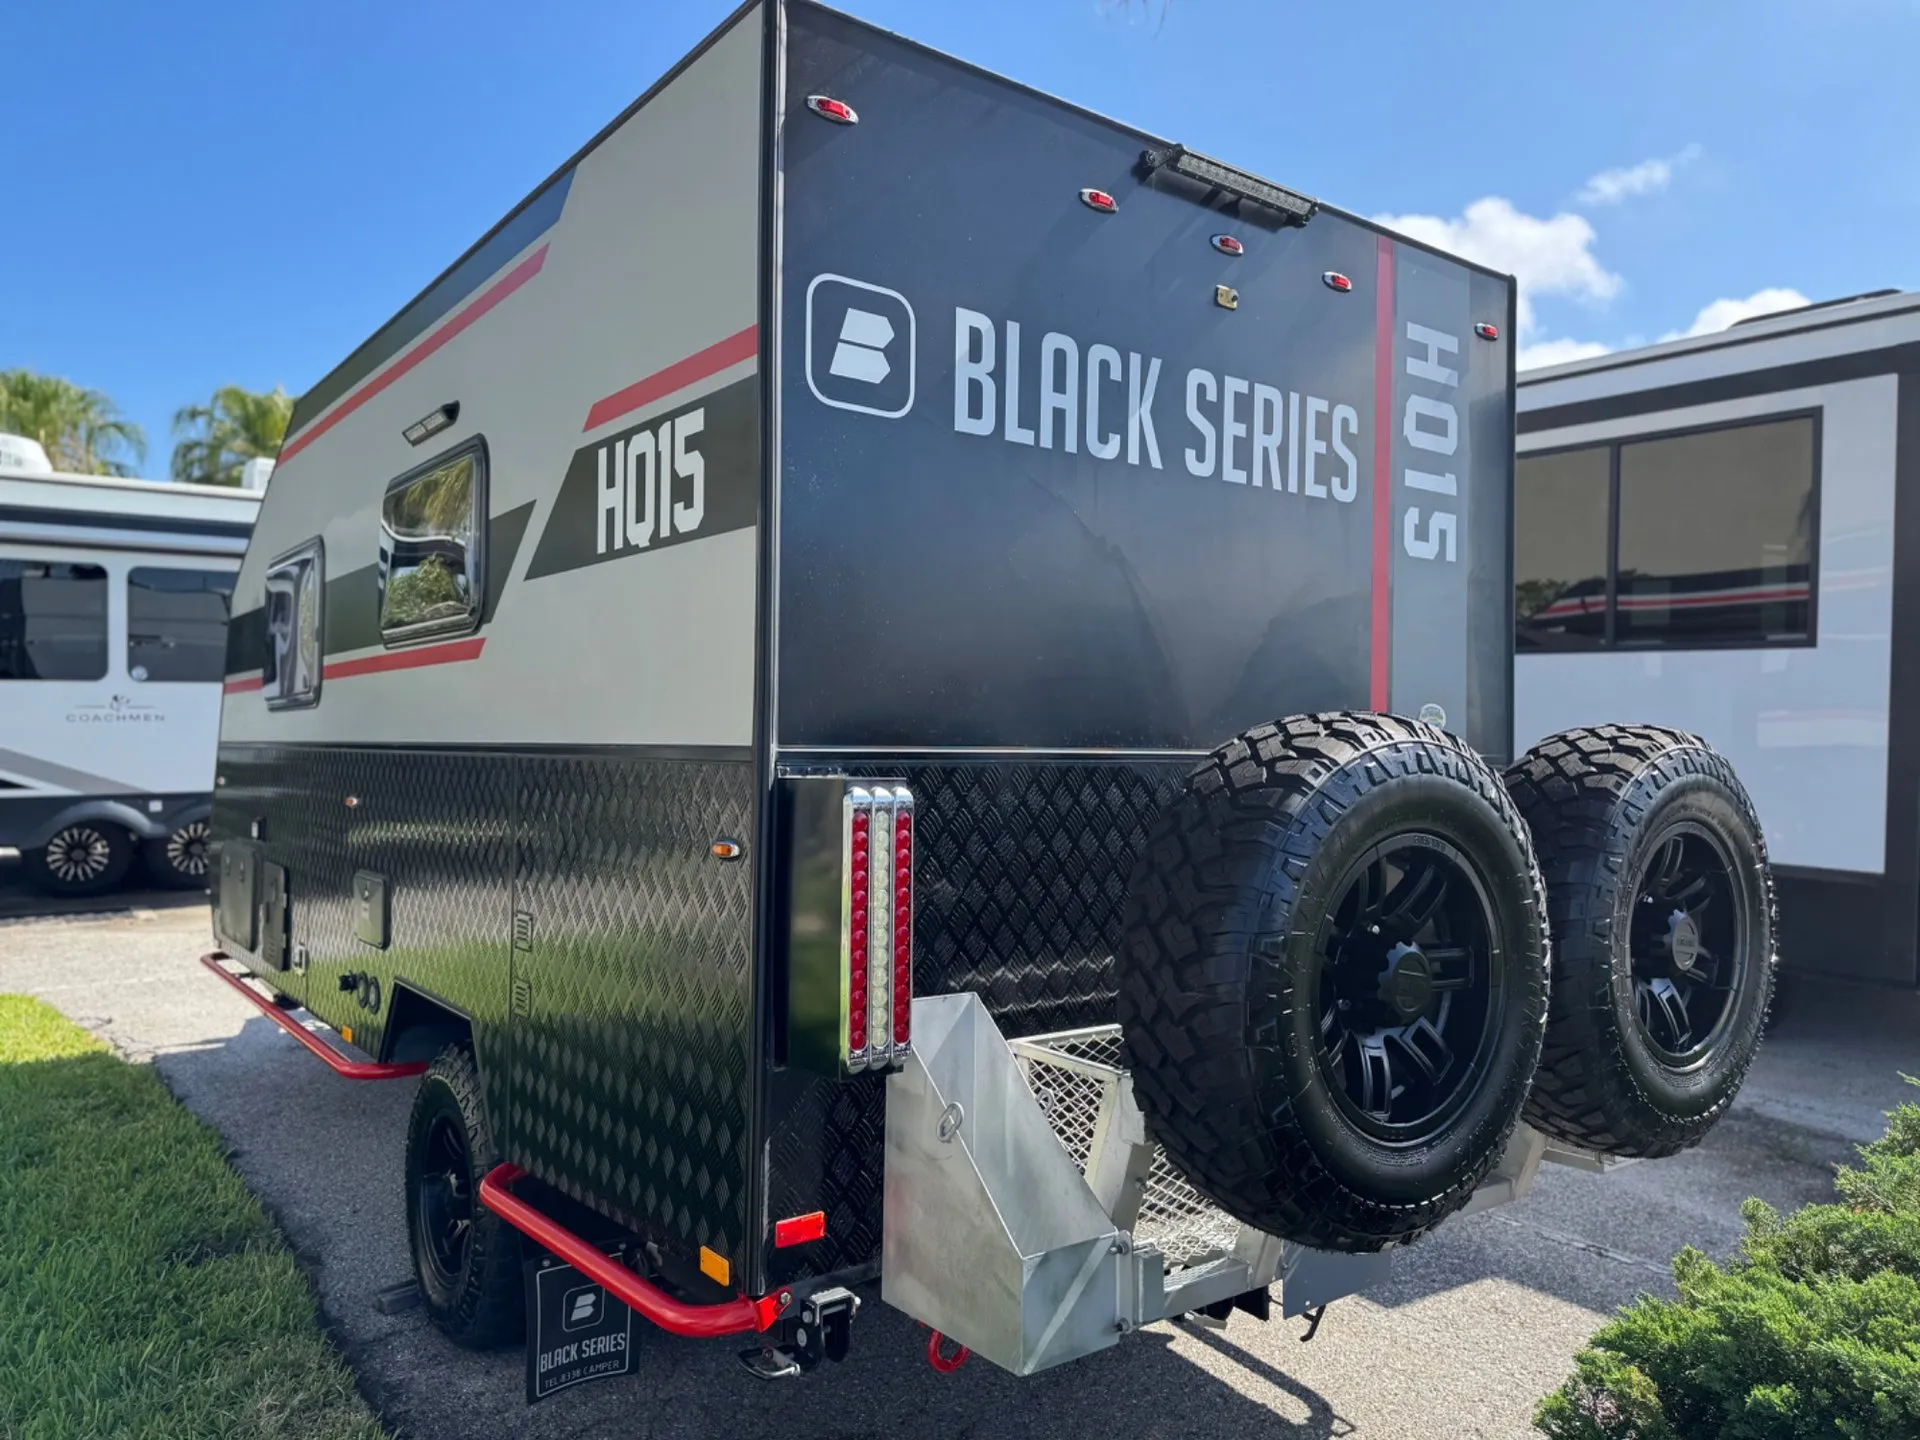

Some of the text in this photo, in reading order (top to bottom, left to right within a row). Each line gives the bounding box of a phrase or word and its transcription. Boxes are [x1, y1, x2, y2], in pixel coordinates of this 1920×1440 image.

[954, 306, 1359, 503] BLACK SERIES
[1402, 321, 1460, 563] HQ15
[597, 406, 705, 555] HQ15
[65, 713, 165, 723] COACHMEN
[540, 1332, 626, 1374] BLACK SERIES
[582, 1359, 620, 1376] CAMPER
